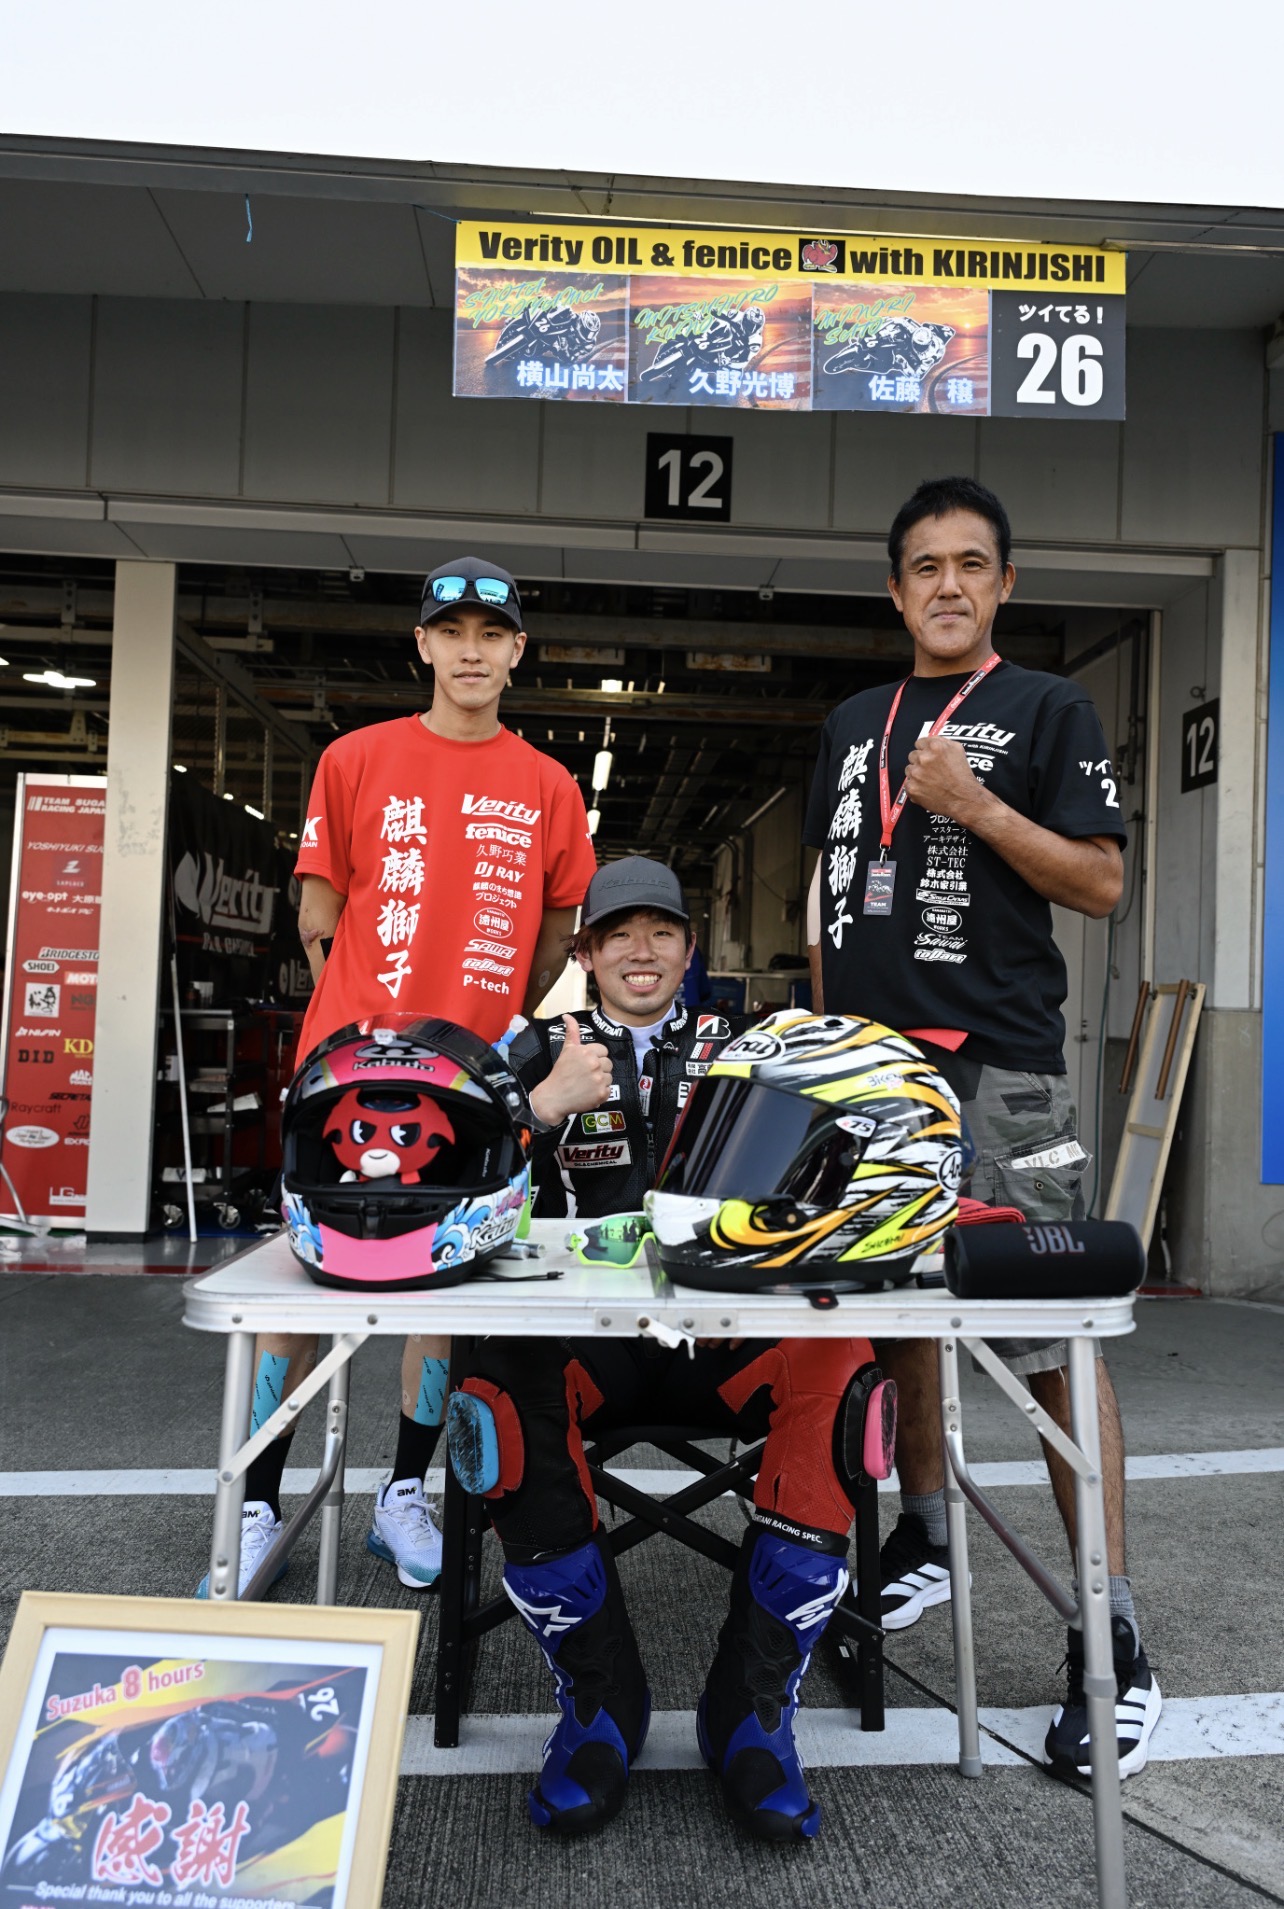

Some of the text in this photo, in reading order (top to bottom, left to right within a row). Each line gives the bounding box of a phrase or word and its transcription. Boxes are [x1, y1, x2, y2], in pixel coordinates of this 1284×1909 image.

[478, 231, 1106, 283] Verity OIL & fenice with KIRINJISHI
[516, 360, 625, 392] 横山尚太
[1016, 332, 1104, 407] 26
[688, 368, 795, 400] 久野光博
[868, 375, 921, 403] 佐藤
[658, 449, 724, 508] 12
[1186, 716, 1216, 778] 12
[41, 805, 76, 813] RACING
[43, 797, 71, 805] TEAM
[461, 794, 541, 825] Verity
[465, 823, 532, 848] fenice
[827, 738, 875, 949] 麒麟獅子
[923, 835, 972, 845] アーキデザイ
[926, 856, 966, 868] ST-TEC
[927, 845, 969, 856] 株式会社
[474, 861, 525, 883] DJ RAY
[926, 868, 964, 880] 株式会社
[377, 795, 428, 999] 麒麟獅子
[475, 892, 518, 909] プロジェクト
[27, 962, 55, 971] SHOEI
[66, 973, 98, 985] MOT
[463, 974, 510, 995] P-tech
[10, 1102, 62, 1114] Raycraft
[585, 1113, 622, 1128] GCM
[562, 1144, 625, 1163] Verity
[1028, 1226, 1085, 1255] JBL
[771, 1519, 801, 1537] RACING
[801, 1532, 823, 1544] SPEC.
[45, 1661, 206, 1721] Suzuka 8 hours
[90, 1791, 253, 1888] 感謝
[34, 1880, 87, 1900] Special
[87, 1885, 126, 1902] thank
[128, 1890, 155, 1906] you
[156, 1890, 172, 1905] to
